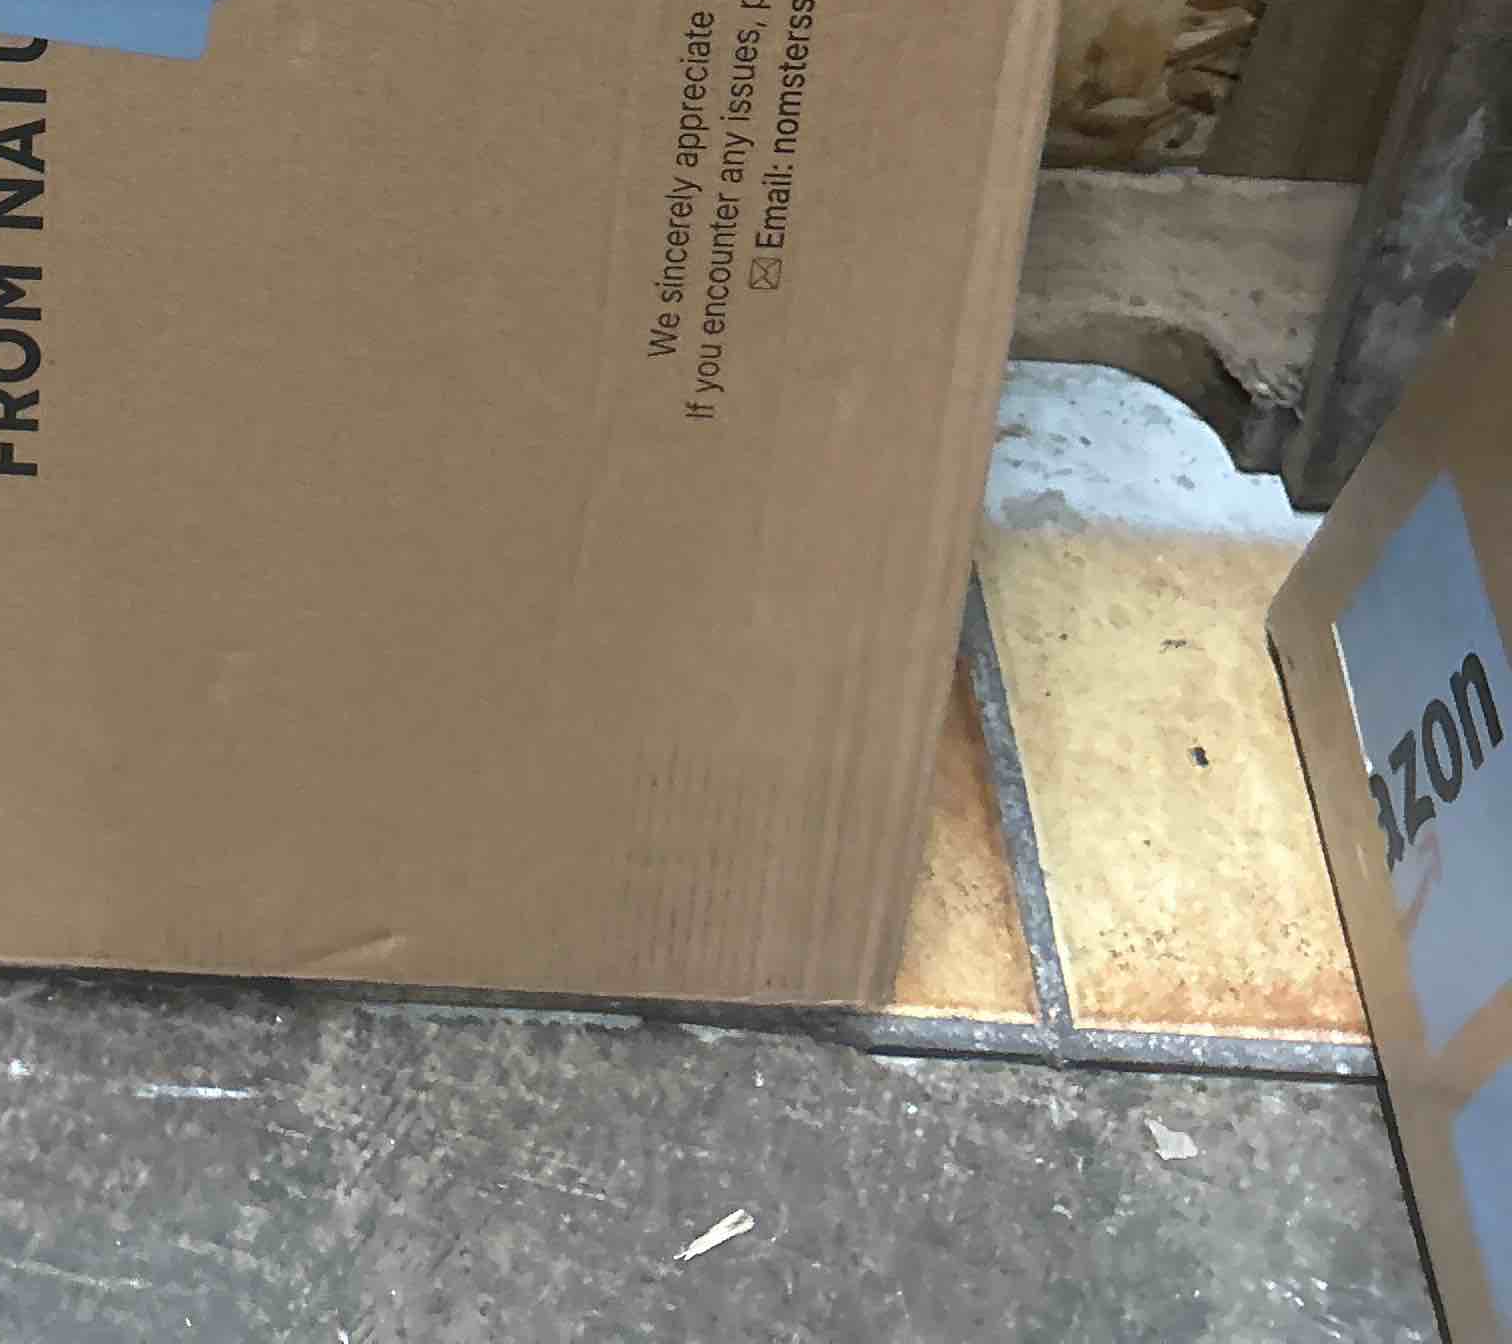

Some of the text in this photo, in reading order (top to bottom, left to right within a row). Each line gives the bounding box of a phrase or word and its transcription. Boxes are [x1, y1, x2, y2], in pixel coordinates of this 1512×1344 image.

[675, 10, 715, 168] appreciate
[720, 21, 767, 123] issues,
[720, 130, 755, 184] any
[654, 176, 702, 304] sincerely
[755, 164, 794, 250] Email:
[703, 192, 741, 335] encounter
[648, 310, 680, 358] We
[696, 342, 725, 393] you
[685, 401, 714, 420] If
